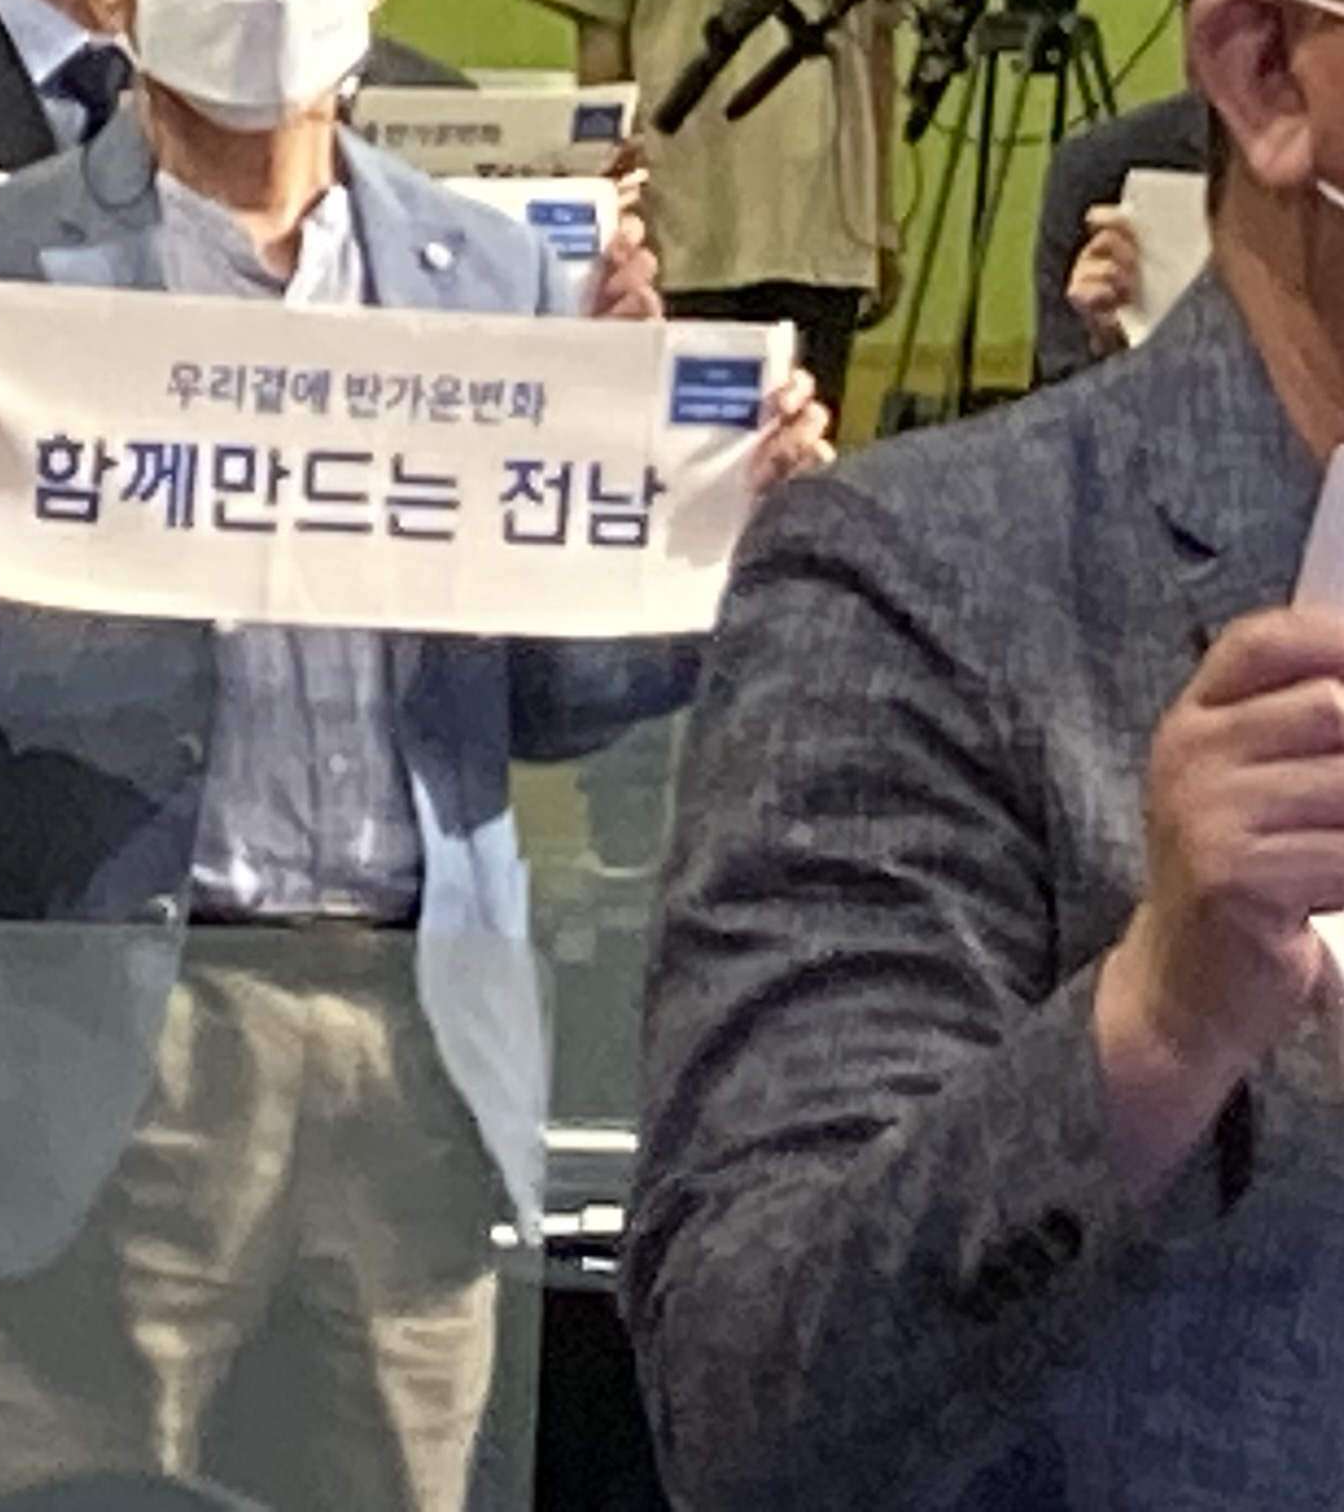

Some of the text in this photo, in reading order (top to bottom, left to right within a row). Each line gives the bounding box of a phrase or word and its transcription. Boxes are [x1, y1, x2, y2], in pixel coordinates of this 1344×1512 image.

[167, 361, 548, 427] 우리곁에 반가운변화
[34, 433, 668, 549] 함께만드는 전남
